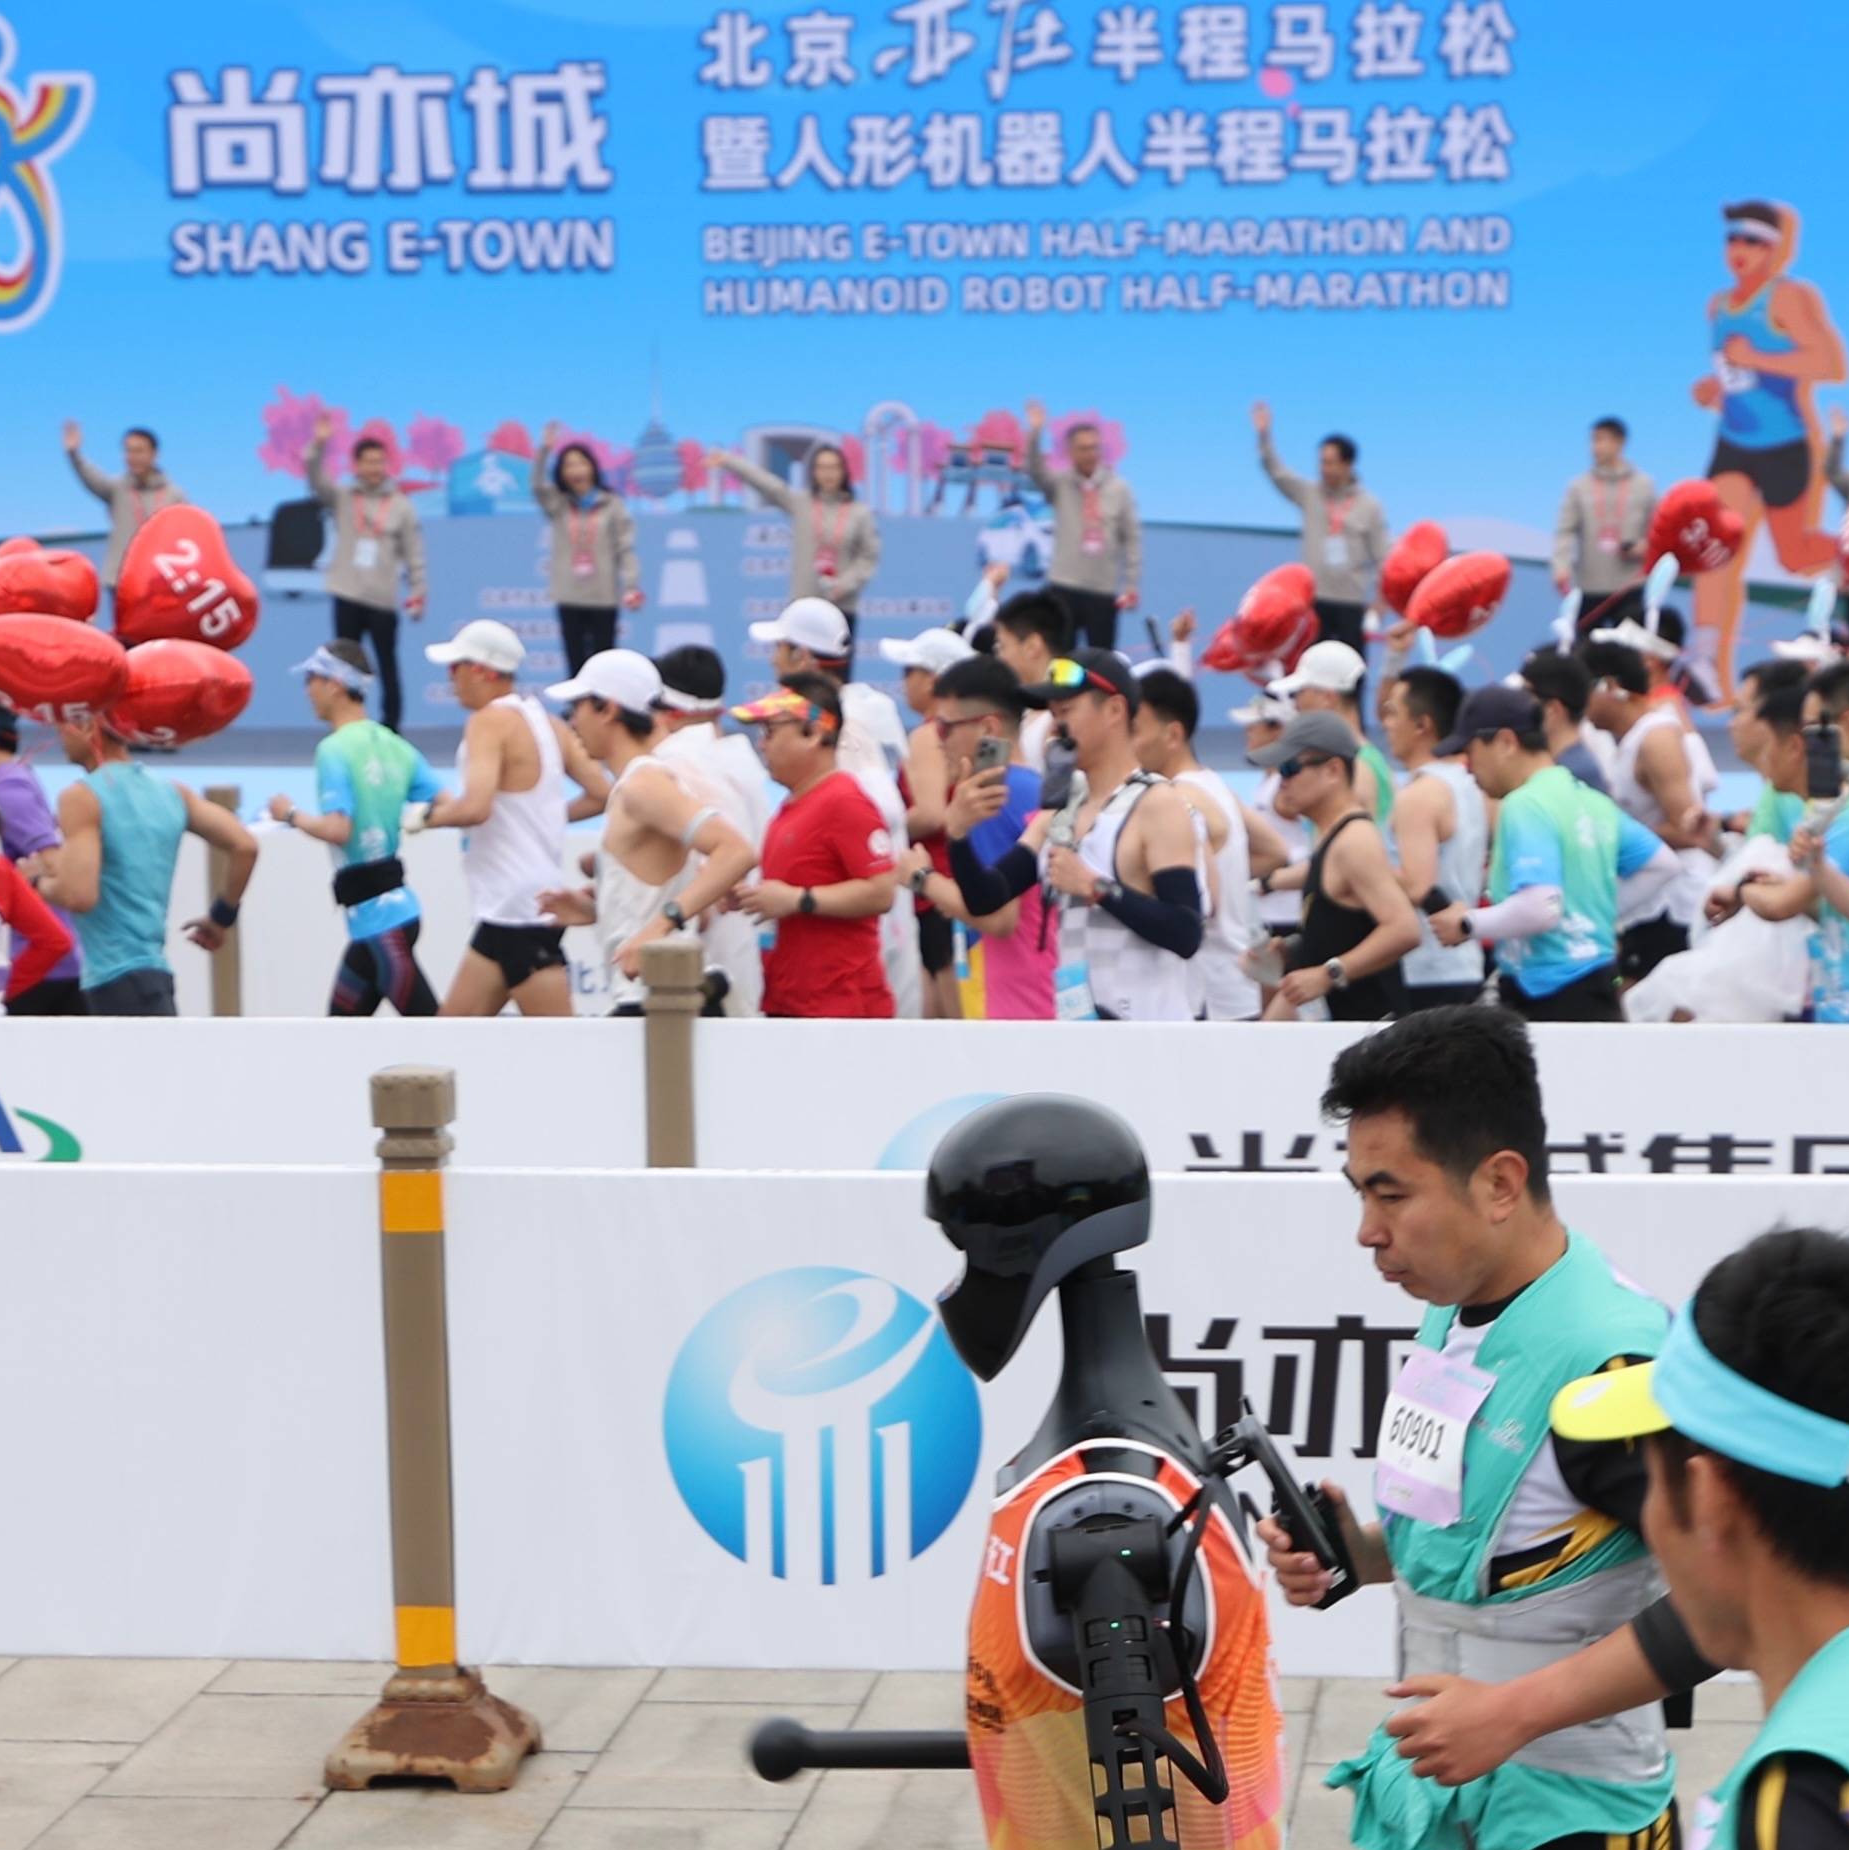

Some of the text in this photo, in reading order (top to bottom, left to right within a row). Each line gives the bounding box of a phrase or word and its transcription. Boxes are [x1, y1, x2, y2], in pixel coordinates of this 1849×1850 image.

[167, 61, 613, 195] 尚亦城
[699, 107, 1514, 192] 暨人形机器人半程马拉松
[171, 219, 615, 275] SHANG E-TOWN
[703, 217, 1512, 269] BEIJING E-TOWN HALF-MARATHON AND
[704, 272, 1510, 315] HUMANOID ROBOT HALF-MARATHON
[153, 538, 241, 636] 2:15
[1390, 1405, 1447, 1461] 60901
